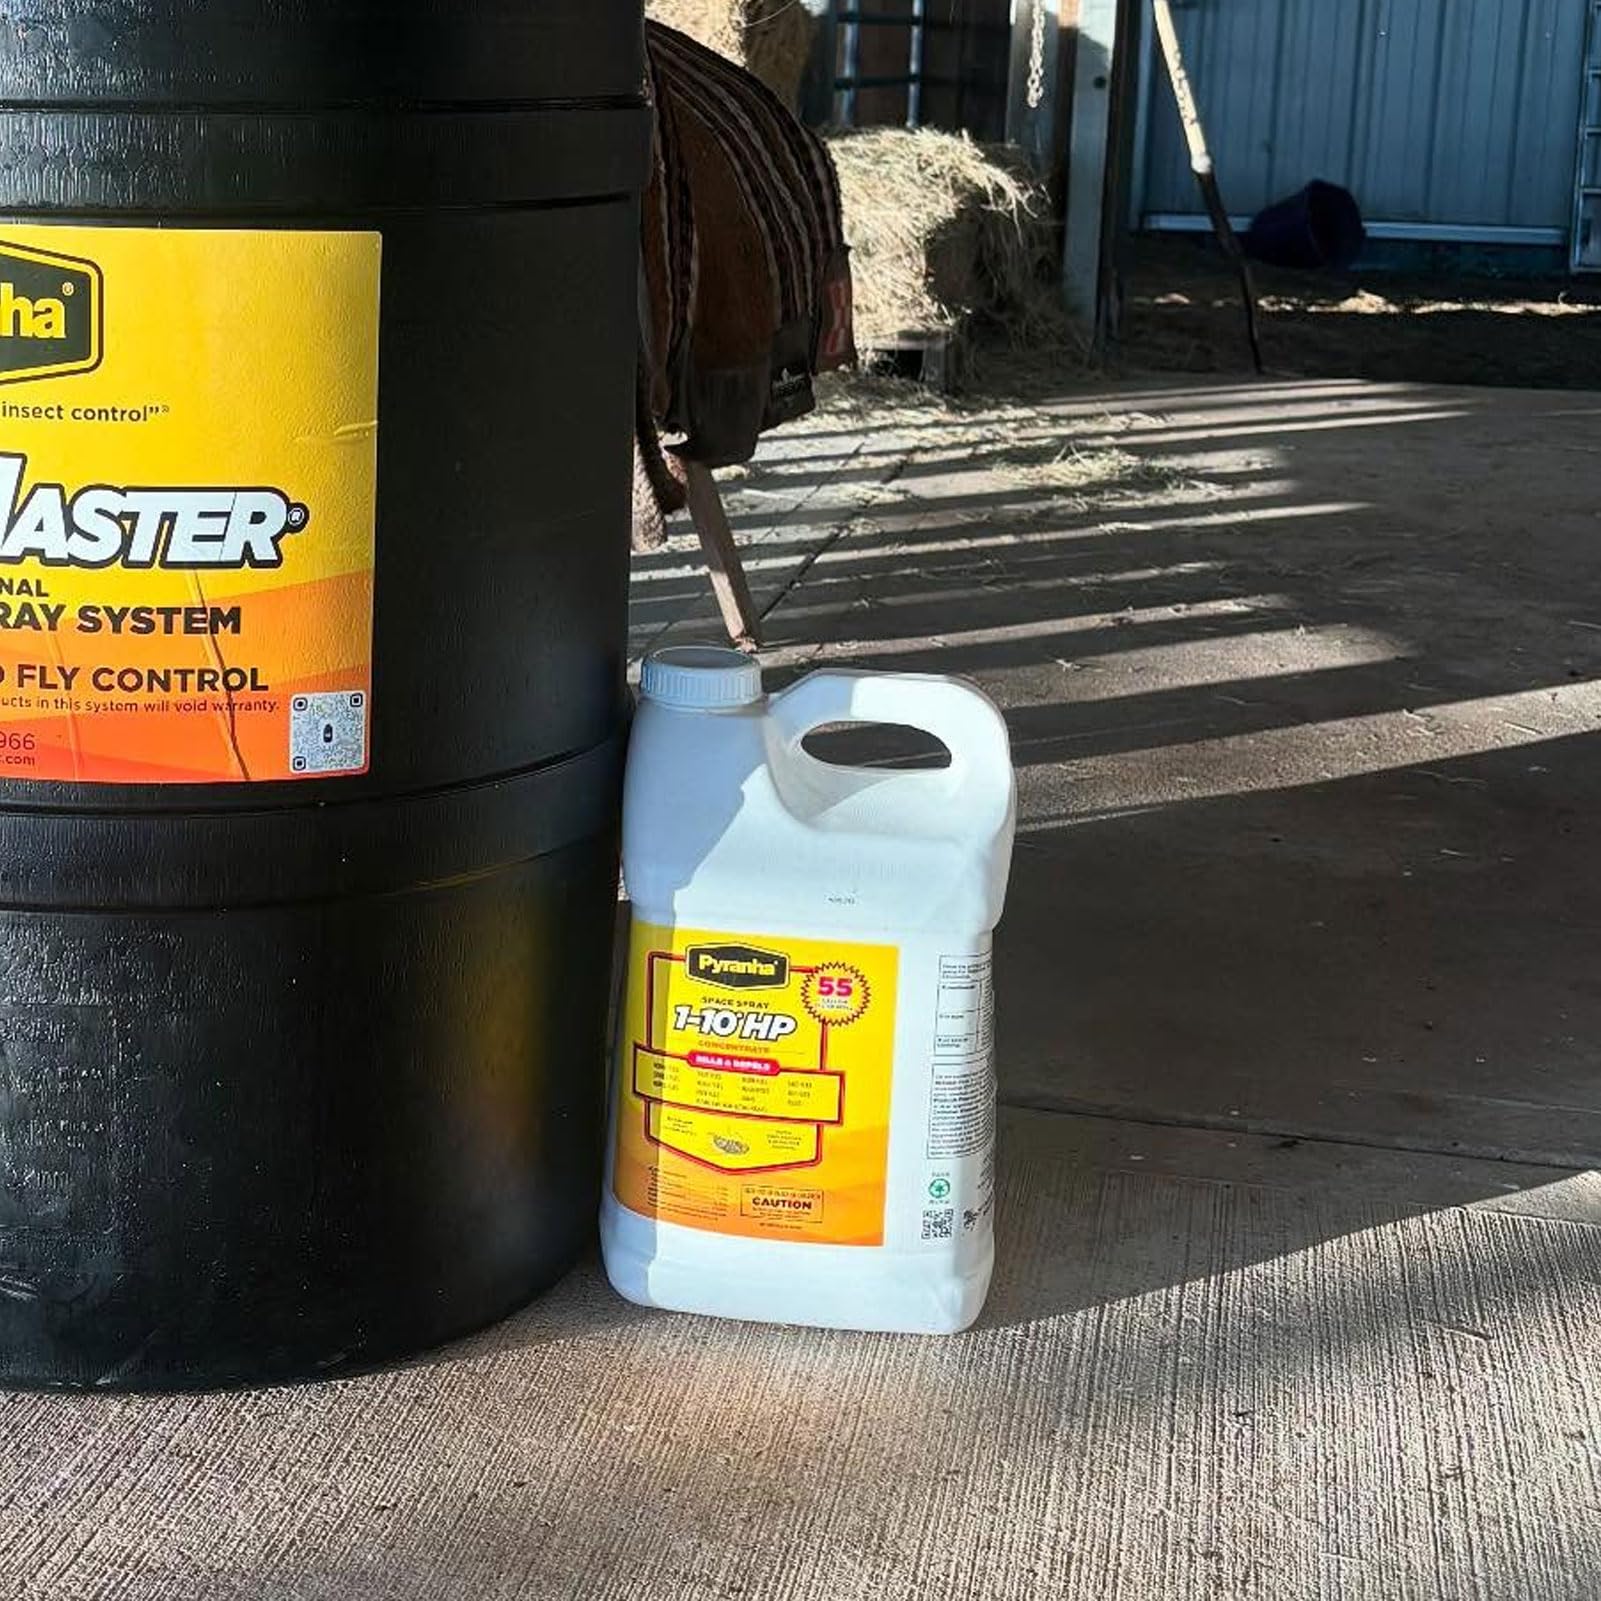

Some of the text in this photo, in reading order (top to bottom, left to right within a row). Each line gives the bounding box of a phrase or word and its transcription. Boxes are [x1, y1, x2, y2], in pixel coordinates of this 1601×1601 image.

[2, 401, 63, 420] insect
[0, 577, 49, 597] NAL
[76, 605, 242, 634] SYSTEM
[17, 664, 80, 690] FLY
[92, 667, 269, 693] CONTROL
[36, 696, 49, 708] in
[54, 698, 81, 710] this
[85, 701, 138, 713] system
[176, 701, 207, 712] void
[0, 754, 35, 766] .com
[699, 954, 775, 976] Pyranha
[818, 976, 853, 997] 55
[702, 996, 769, 1010] SPACE SPRAY
[739, 1011, 797, 1041] HP
[752, 1197, 812, 1210] CAUTION
